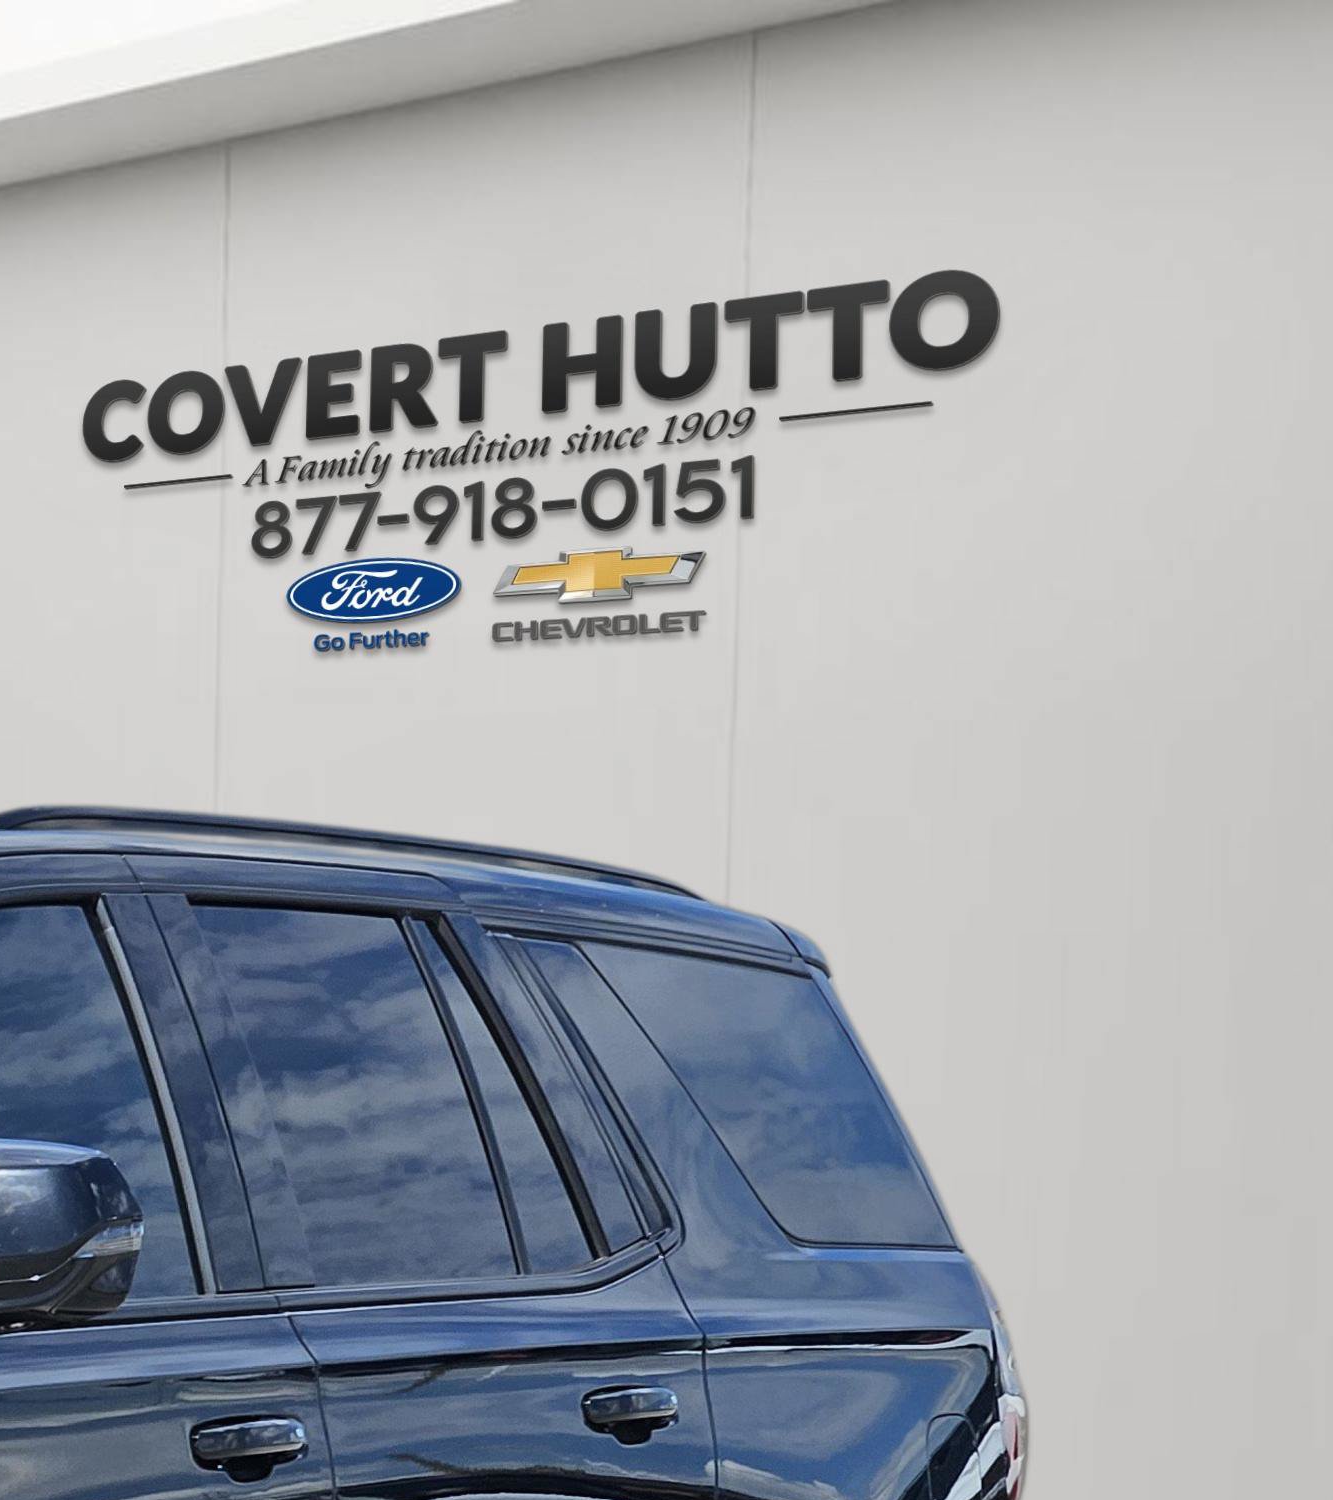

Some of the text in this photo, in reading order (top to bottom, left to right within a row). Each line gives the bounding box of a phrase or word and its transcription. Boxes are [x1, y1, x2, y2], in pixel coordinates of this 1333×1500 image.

[83, 270, 1000, 464] COVERT HUTTO
[243, 406, 756, 489] A Family tradition since 1909
[251, 455, 755, 561] 877-918-0151
[321, 569, 421, 612] Ford
[314, 629, 429, 652] Go Further
[492, 610, 707, 643] CHEVROLET
